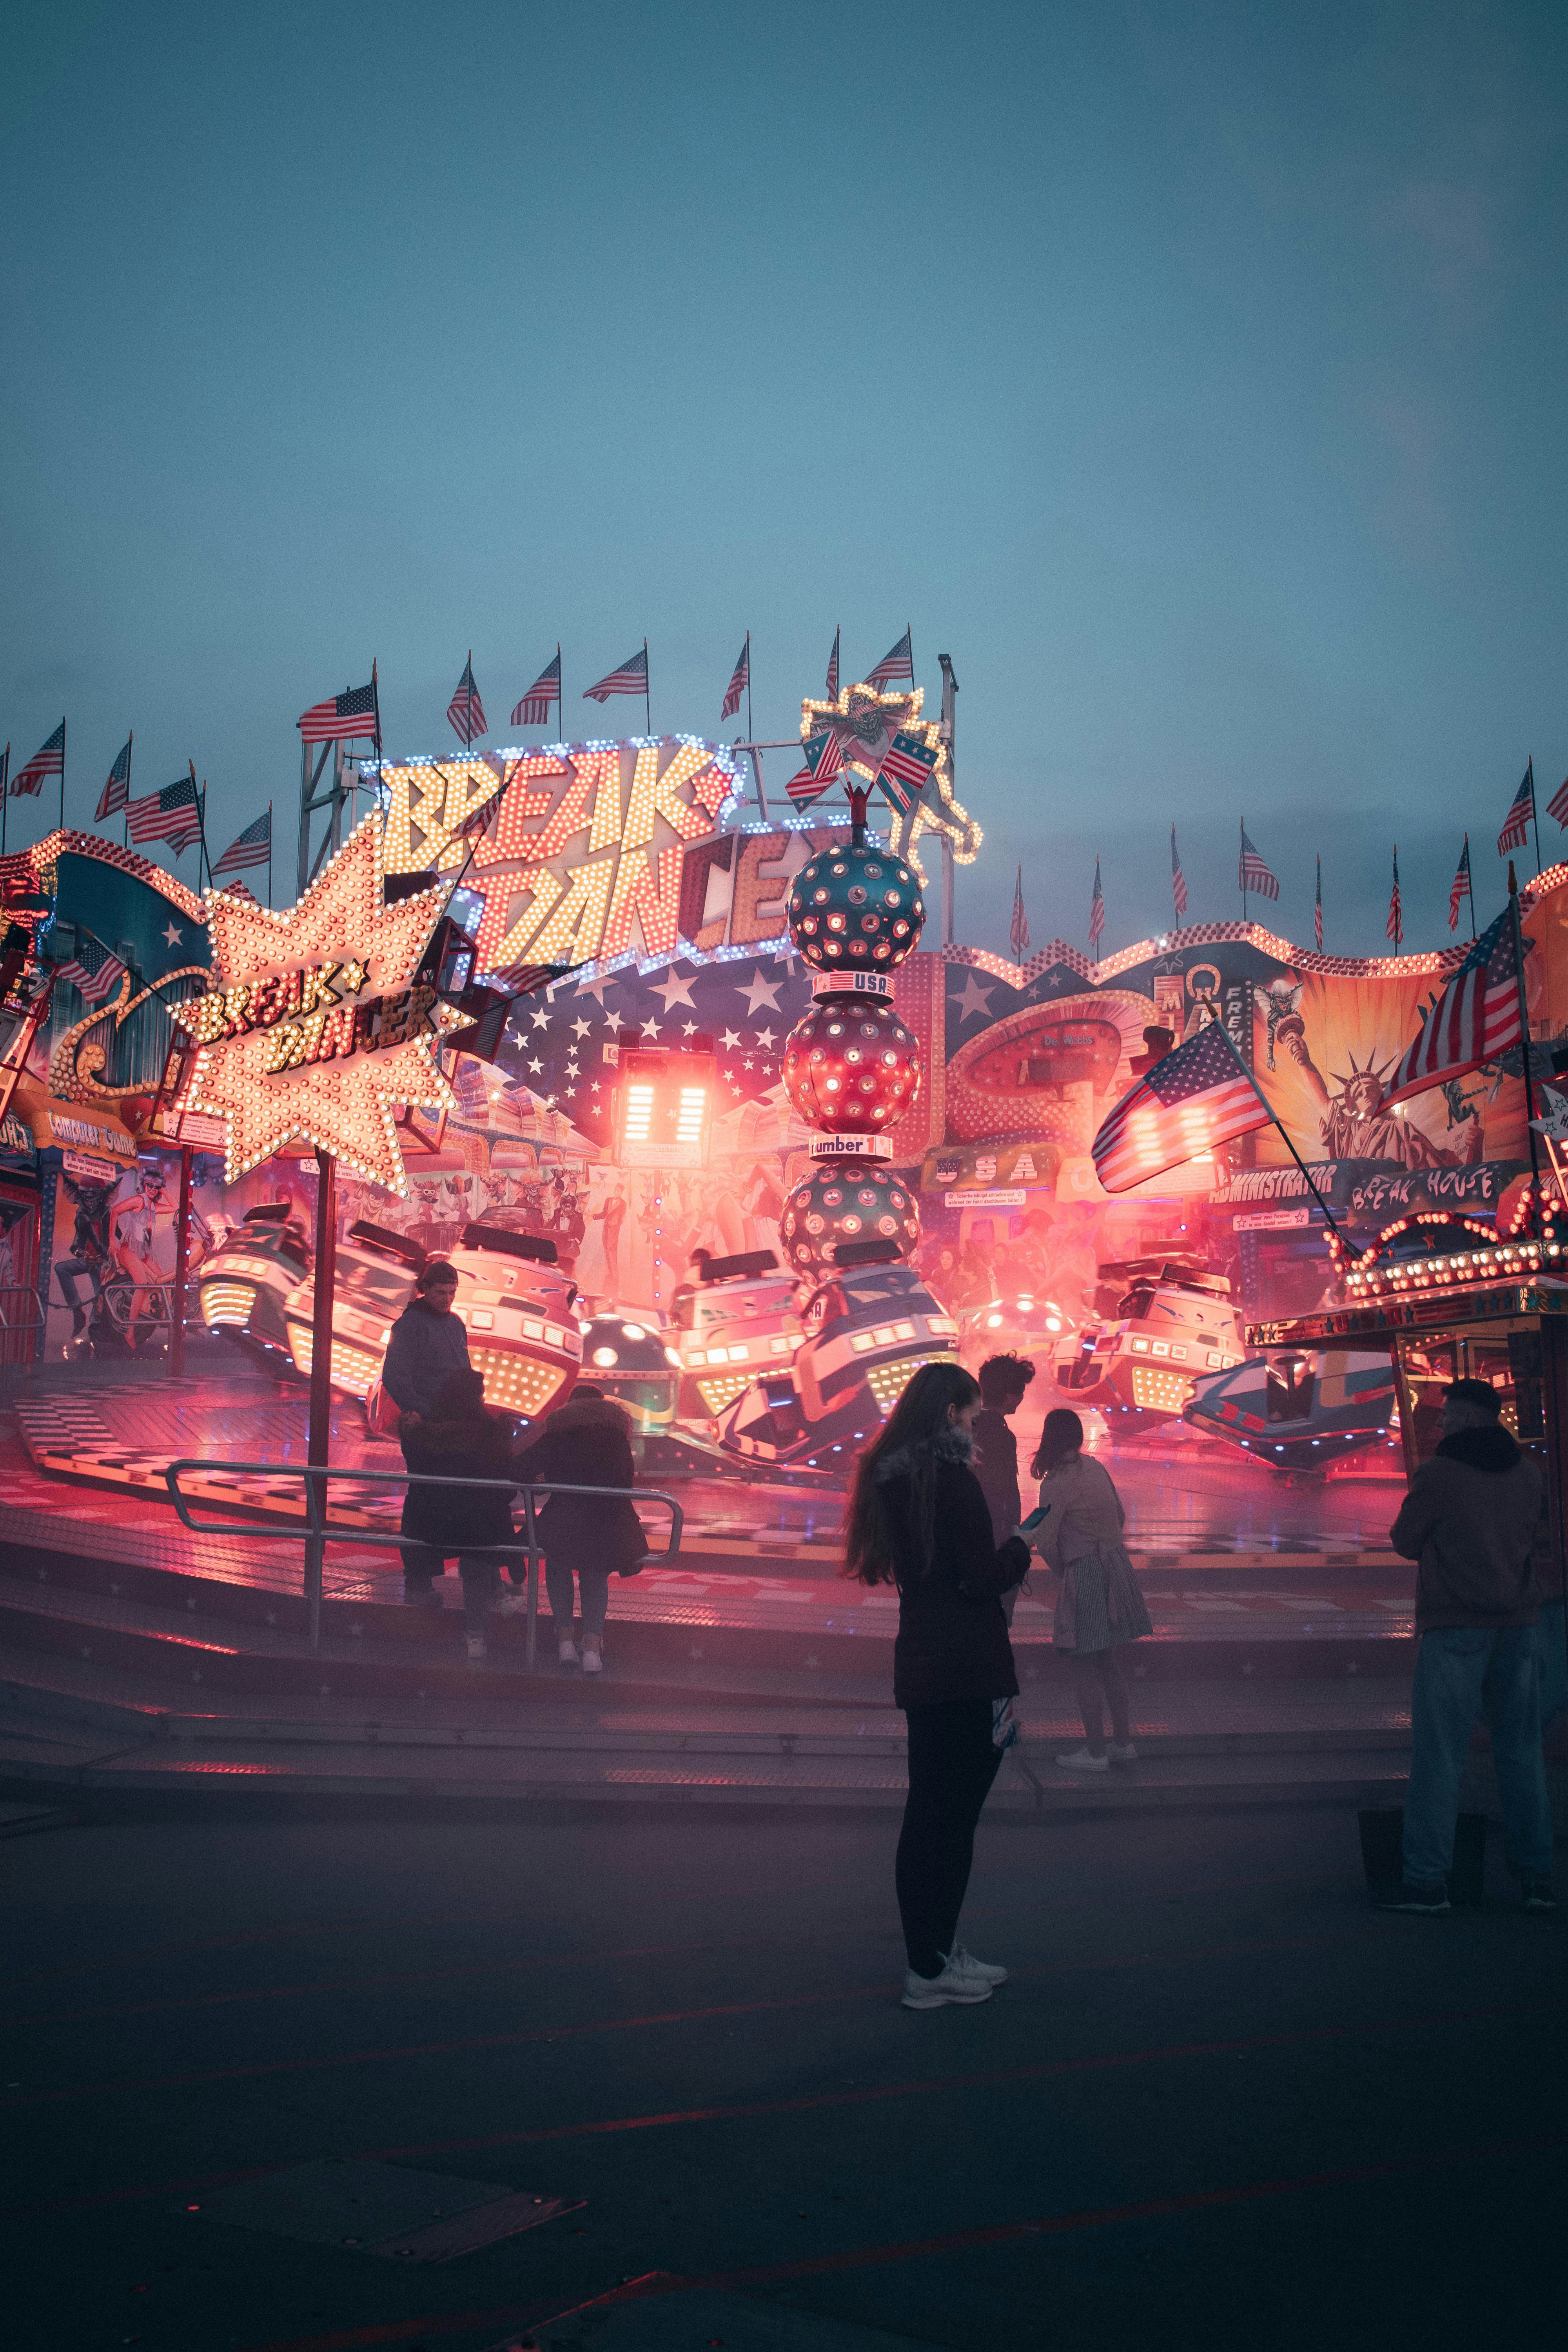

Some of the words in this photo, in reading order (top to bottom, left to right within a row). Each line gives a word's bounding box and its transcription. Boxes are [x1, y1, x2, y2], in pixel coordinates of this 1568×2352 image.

[381, 744, 715, 873] BREAK
[458, 825, 852, 975] DANCE
[197, 960, 343, 1046] BREAK
[855, 974, 886, 993] USA
[260, 985, 438, 1075] DANCER
[867, 1137, 874, 1153] 1
[1352, 1177, 1416, 1210] BREAK
[1427, 1167, 1493, 1198] HOUSE
